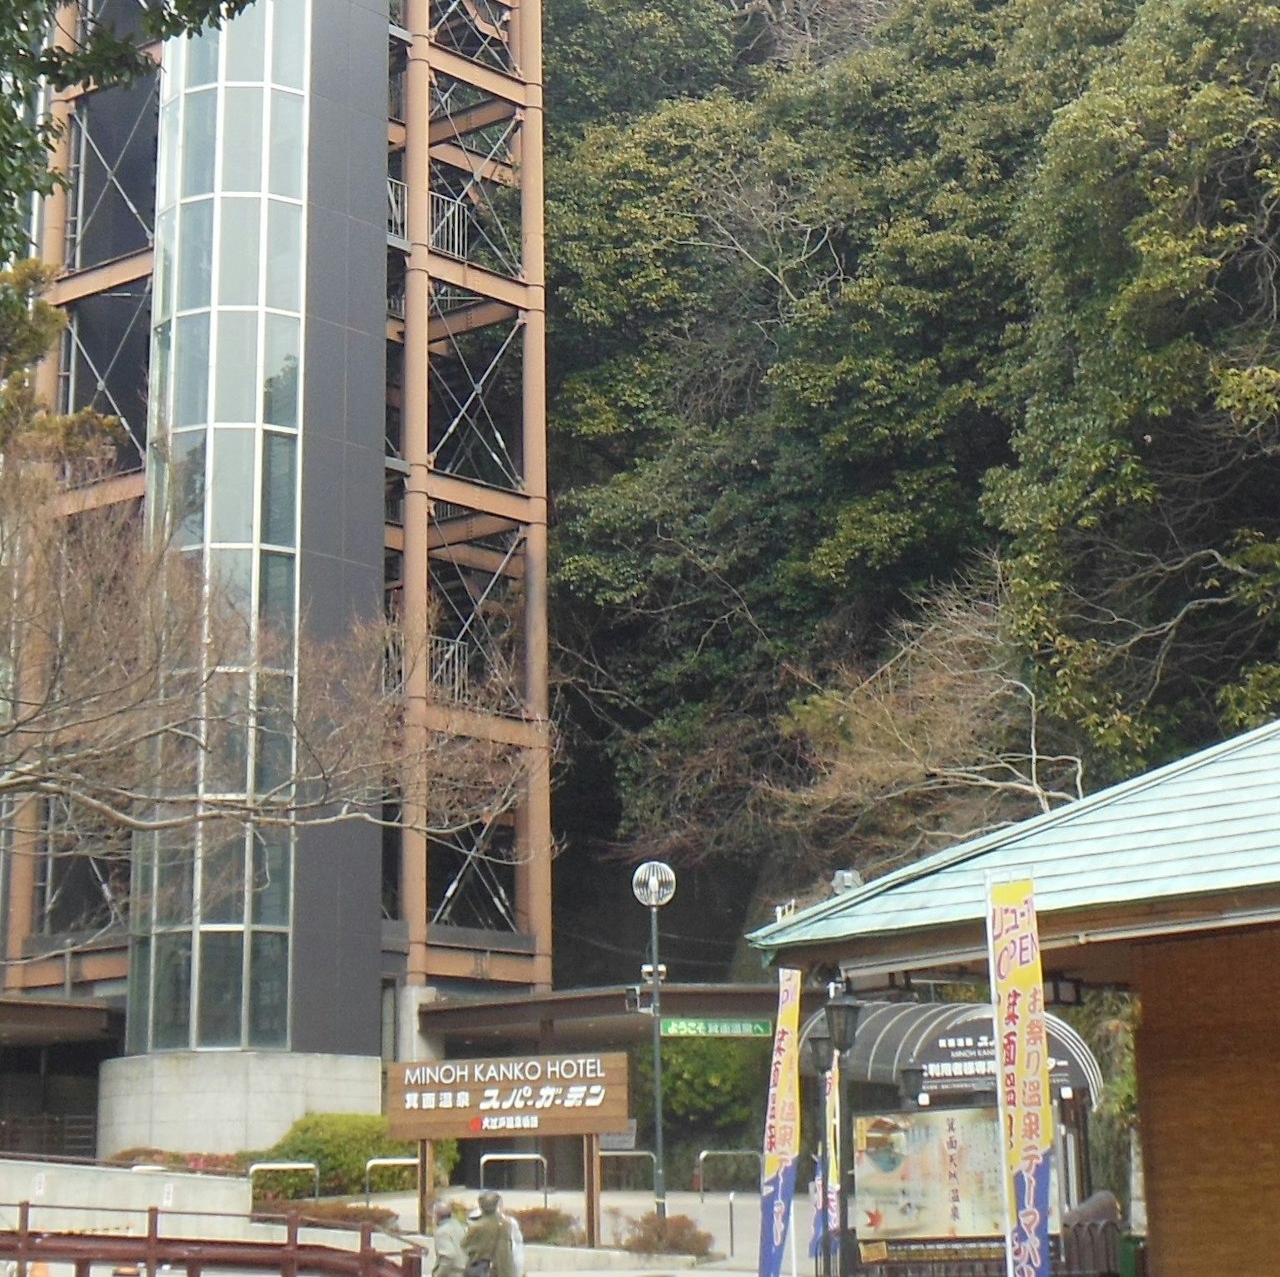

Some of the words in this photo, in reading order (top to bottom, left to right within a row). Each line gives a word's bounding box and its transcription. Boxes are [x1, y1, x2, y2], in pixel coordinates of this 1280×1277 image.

[405, 1065, 469, 1085] MINOH
[474, 1060, 541, 1082] KANKO
[547, 1058, 606, 1079] HOTEL
[405, 1092, 470, 1110] 箕面温泉
[479, 1085, 606, 1111] スパーガーデン
